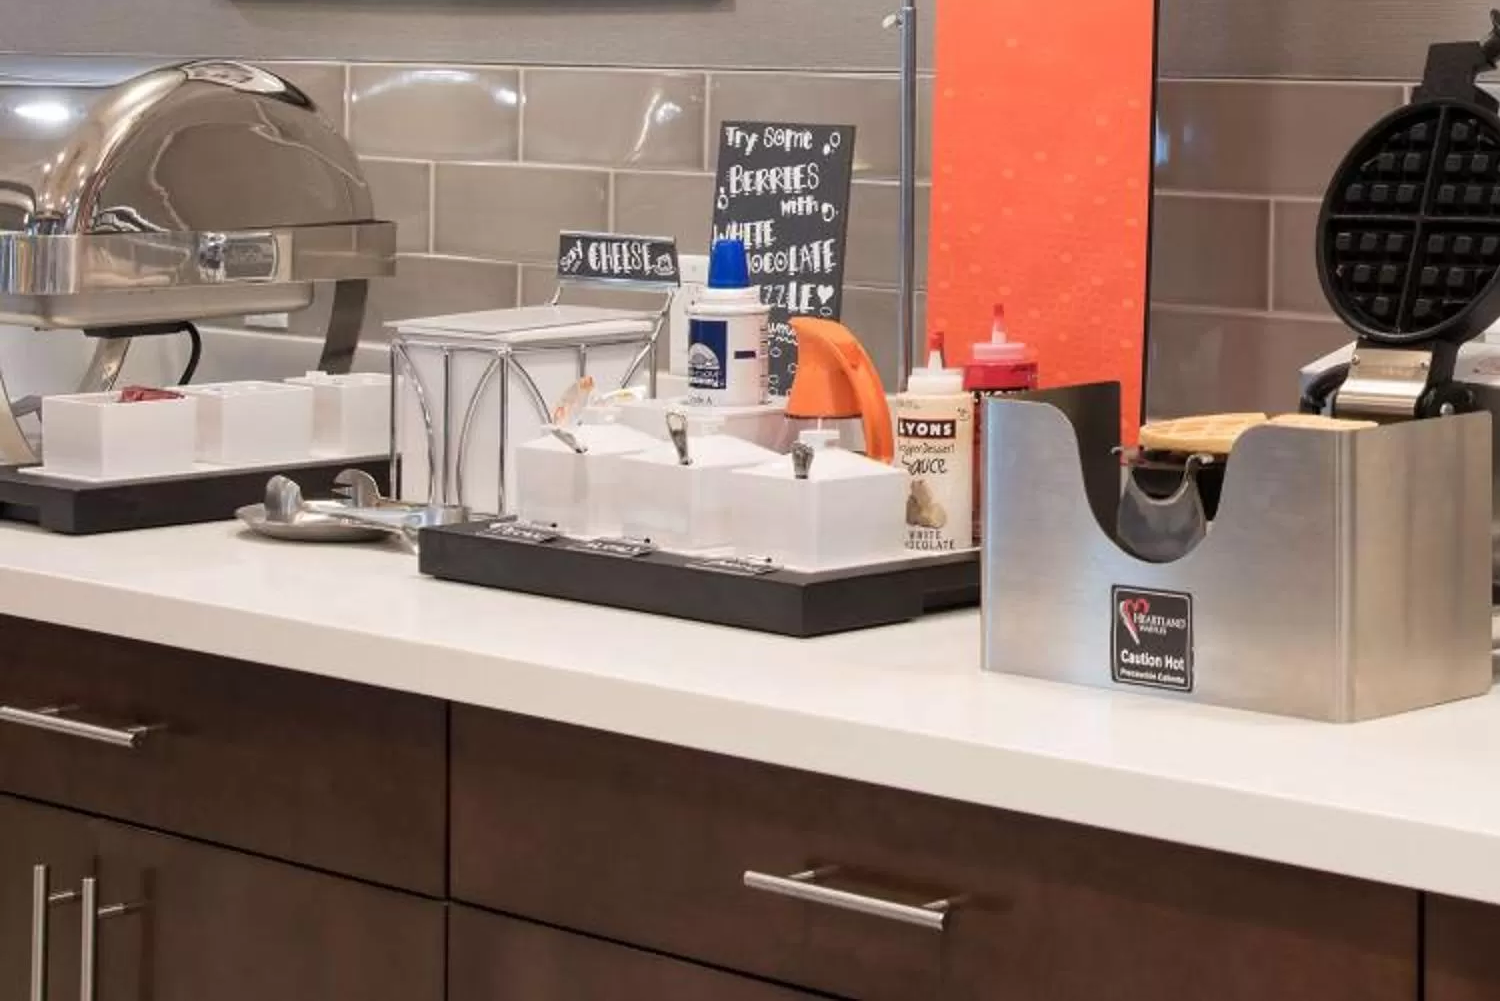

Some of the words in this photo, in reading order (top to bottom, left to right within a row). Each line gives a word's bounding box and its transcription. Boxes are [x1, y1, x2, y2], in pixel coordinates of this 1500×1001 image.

[728, 162, 819, 198] BERRIES
[587, 241, 655, 275] CHEESE
[747, 238, 836, 276] OCOLATE
[761, 280, 816, 314] ZZLE
[899, 421, 953, 437] LYONS
[1121, 648, 1163, 668] Caution
[1165, 654, 1186, 672] Hot
